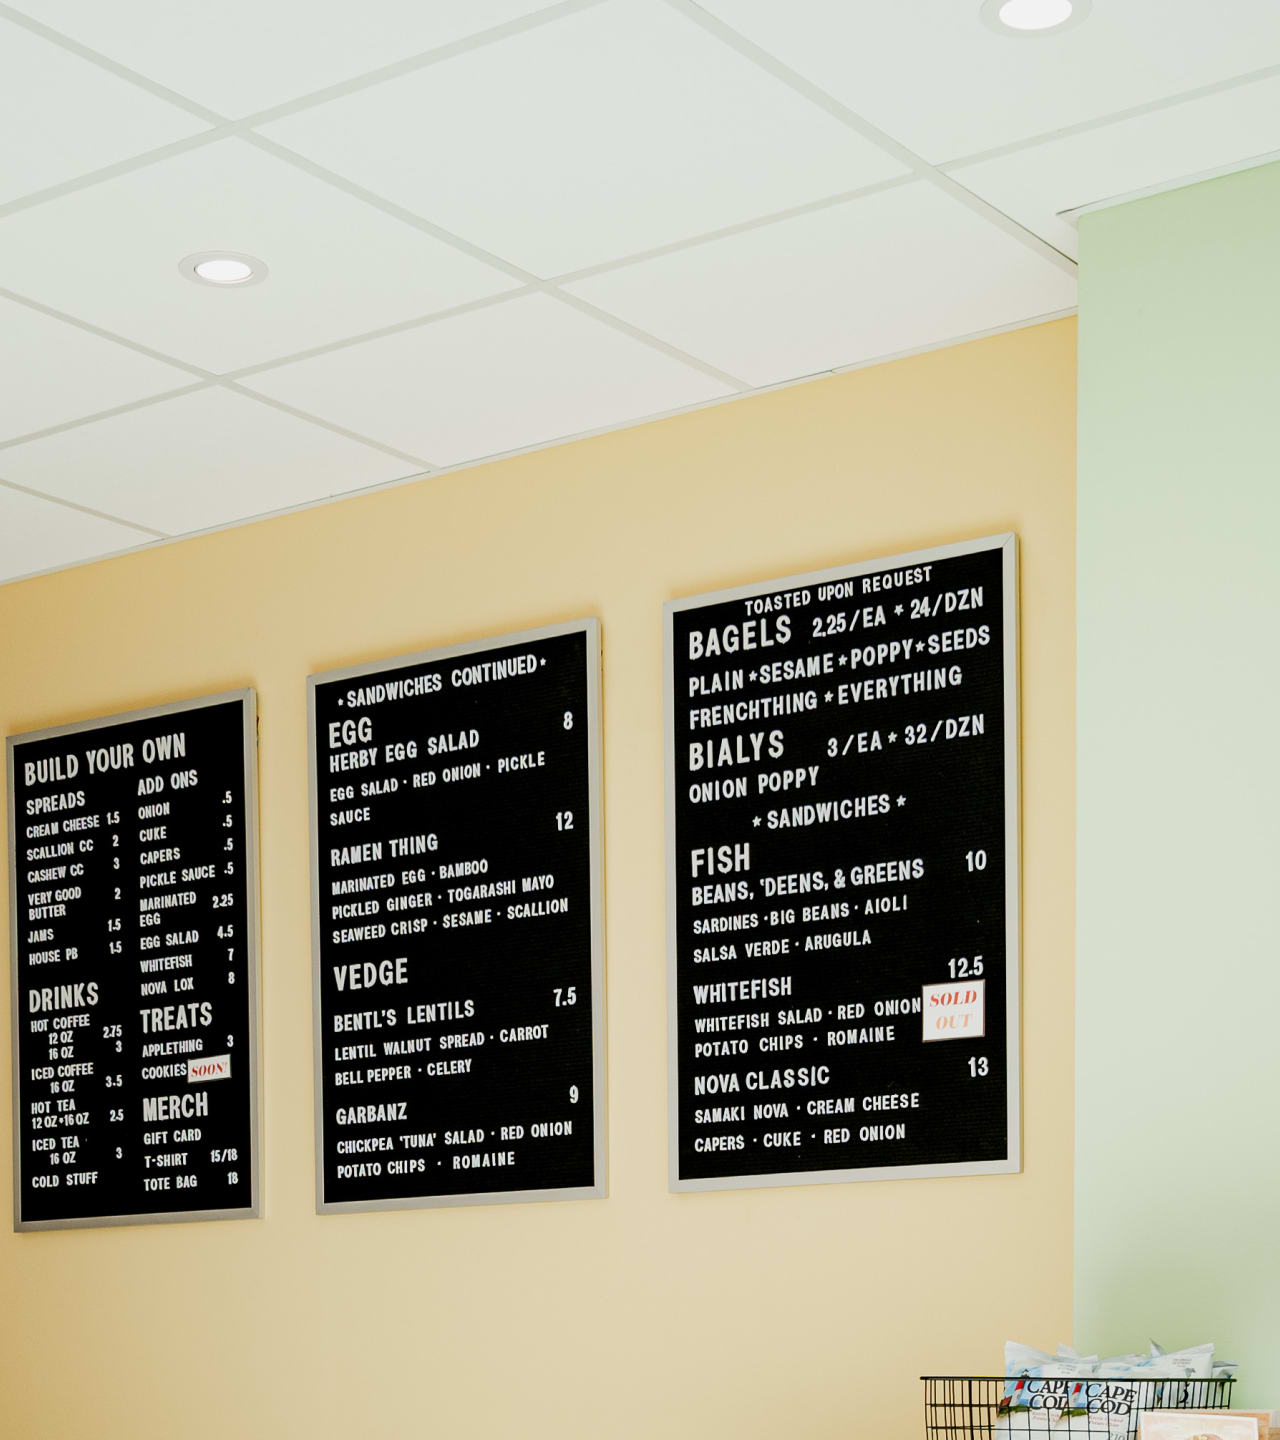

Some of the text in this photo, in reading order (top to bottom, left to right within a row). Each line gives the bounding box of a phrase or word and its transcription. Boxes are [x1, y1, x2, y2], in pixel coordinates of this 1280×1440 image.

[744, 565, 933, 617] TOASTED UPON REQUEST
[689, 614, 792, 661] BAGELS
[328, 716, 373, 749] EGG
[329, 711, 574, 774] HERBY EGG SALAD 8
[24, 732, 186, 787] BUILD YOUR OWN
[689, 729, 784, 772] BIALYS
[137, 769, 199, 797] ADD ONS
[688, 765, 820, 804] ONION POPPY
[26, 790, 86, 816] SPREADS
[26, 821, 59, 839] CREAM
[62, 814, 100, 833] CHEESE
[330, 810, 574, 867] RAMEN THING 12
[26, 834, 119, 862] SCALLION CC 2
[691, 842, 750, 878] FISH
[691, 880, 754, 906] BEANS,
[850, 858, 925, 886] GREENS
[965, 849, 987, 873] 10
[332, 873, 555, 920] PICKLED GINGER TOGARASHI MAYO
[139, 947, 234, 974] WHITEFISH 7
[333, 957, 409, 992] VEDGE
[692, 955, 984, 1005] WHITEFISH 12.5
[29, 981, 99, 1013] DRINKS
[407, 999, 475, 1025] LENTILS
[553, 986, 577, 1008] 7.5
[930, 990, 979, 1007] SOLD
[30, 1013, 91, 1033] HOT COFFEE
[139, 1001, 213, 1034] TREATS
[935, 1013, 974, 1031] OUT
[142, 1034, 234, 1058] APPLETHING 3
[694, 1056, 989, 1096] NOVA CLASSIC 13
[142, 1091, 209, 1123] MERCH
[335, 1084, 579, 1125] GARBANZ 9
[143, 1127, 202, 1145] GIFT CARD
[31, 1171, 99, 1189] COLD STUFF
[143, 1171, 239, 1192] TOTE BAG 18
[1084, 1383, 1138, 1402] CAPE
[1086, 1399, 1131, 1416] COD
